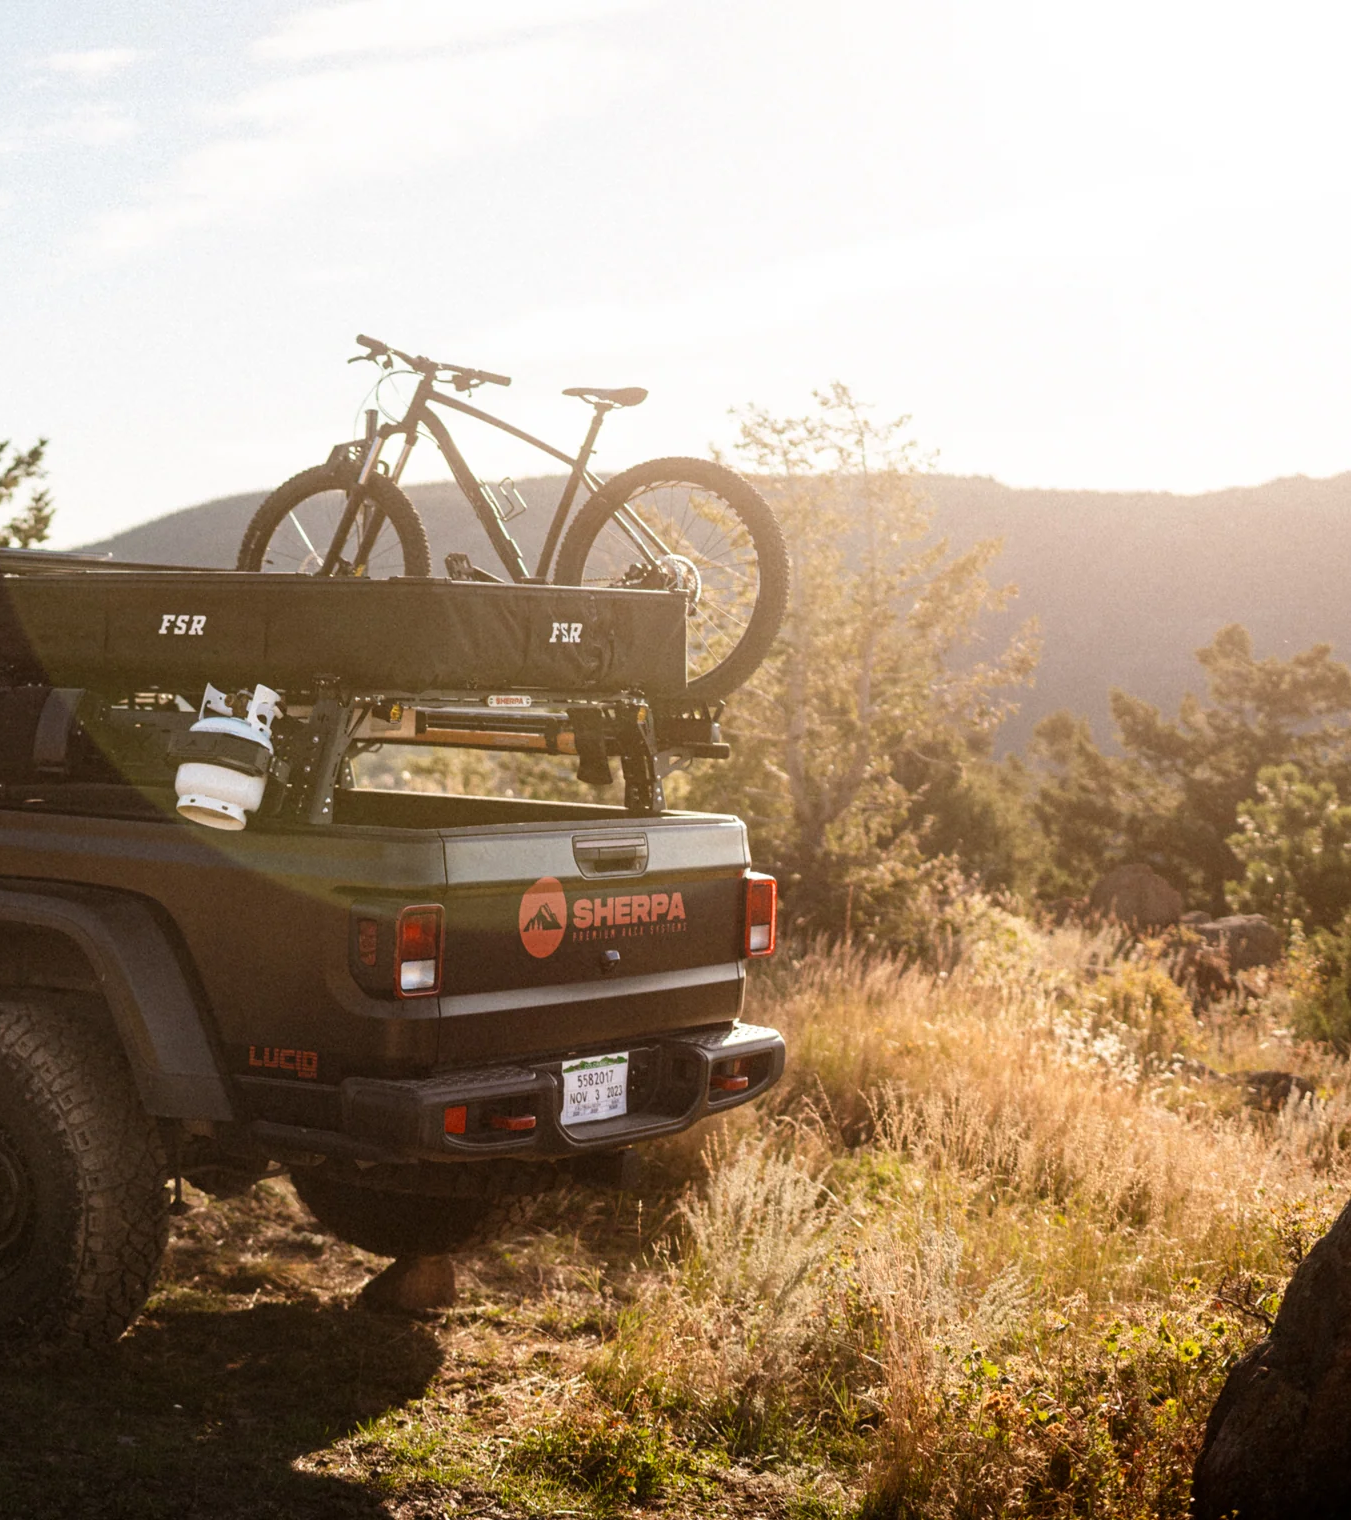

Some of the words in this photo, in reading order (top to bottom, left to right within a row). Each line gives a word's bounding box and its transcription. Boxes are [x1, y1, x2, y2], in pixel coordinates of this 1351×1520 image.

[158, 614, 207, 636] FSR
[549, 622, 583, 643] FSR
[495, 697, 524, 705] SHERPA
[572, 892, 686, 929] SHERPA
[572, 929, 616, 942] PREMIUM
[650, 922, 687, 935] SYSTEMS
[249, 1045, 318, 1071] LUCID
[577, 1069, 614, 1088] 5582017
[569, 1091, 588, 1104] NOV
[595, 1089, 600, 1101] 3
[607, 1085, 623, 1098] 2023
